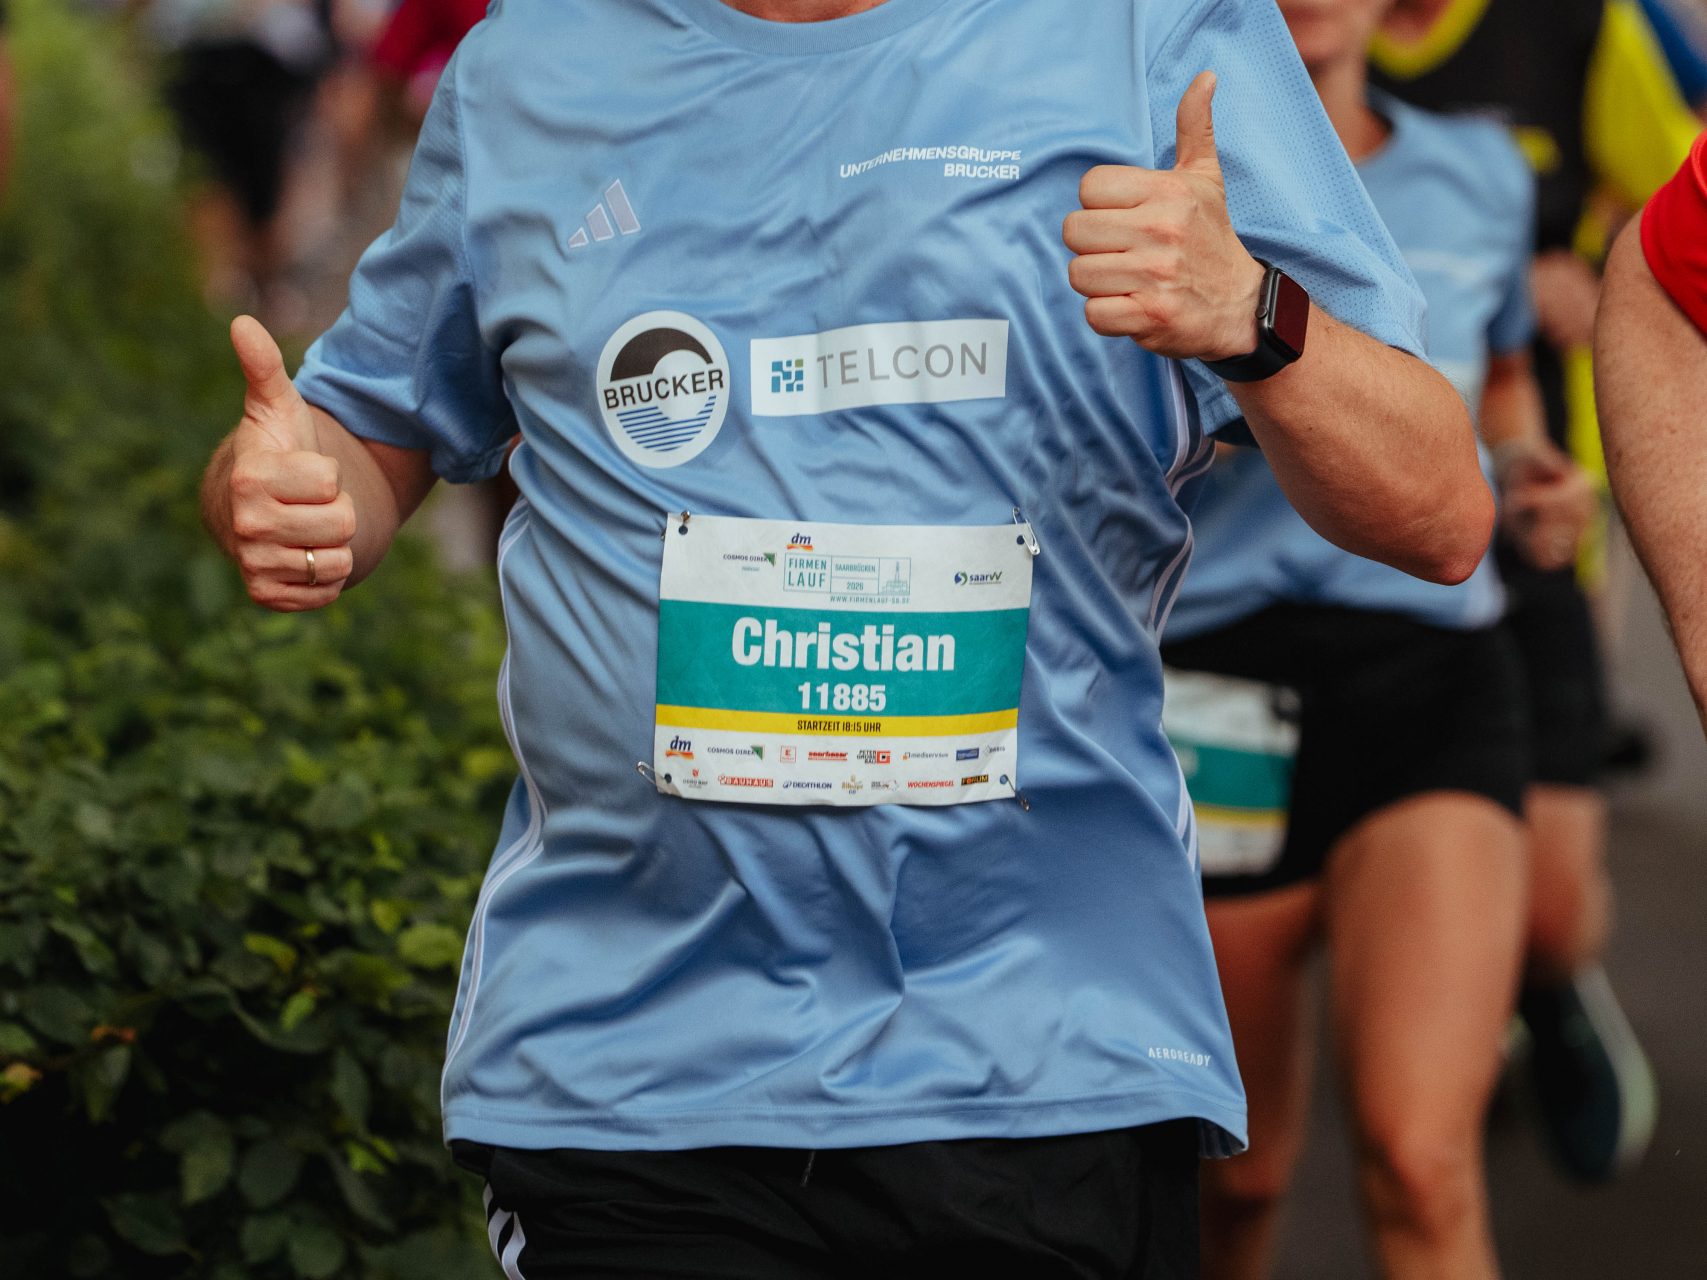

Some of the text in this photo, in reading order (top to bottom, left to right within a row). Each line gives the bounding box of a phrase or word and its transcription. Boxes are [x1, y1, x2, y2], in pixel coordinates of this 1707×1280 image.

[840, 145, 1021, 178] UNTERNEHMENSGRUPPE
[944, 163, 1020, 180] BRUCKER
[817, 342, 988, 389] TELCON
[603, 368, 724, 410] BRUCKER
[790, 533, 812, 545] dm
[789, 558, 827, 570] FIRMEN
[835, 563, 876, 573] SAARBRÜCKEN
[788, 571, 826, 588] LAUF
[731, 616, 956, 672] Christian
[798, 682, 887, 712] 11885
[797, 720, 881, 733] STARTZEIT 18:15 UHR
[670, 735, 692, 752] dm
[707, 747, 734, 756] COSMOS
[725, 777, 774, 788] BAUHAUS
[792, 781, 832, 790] DECATHLON
[907, 780, 954, 789] WOCHENSPIEGEL
[962, 775, 989, 786] FORUM
[1148, 1047, 1211, 1067] AEROREADY
